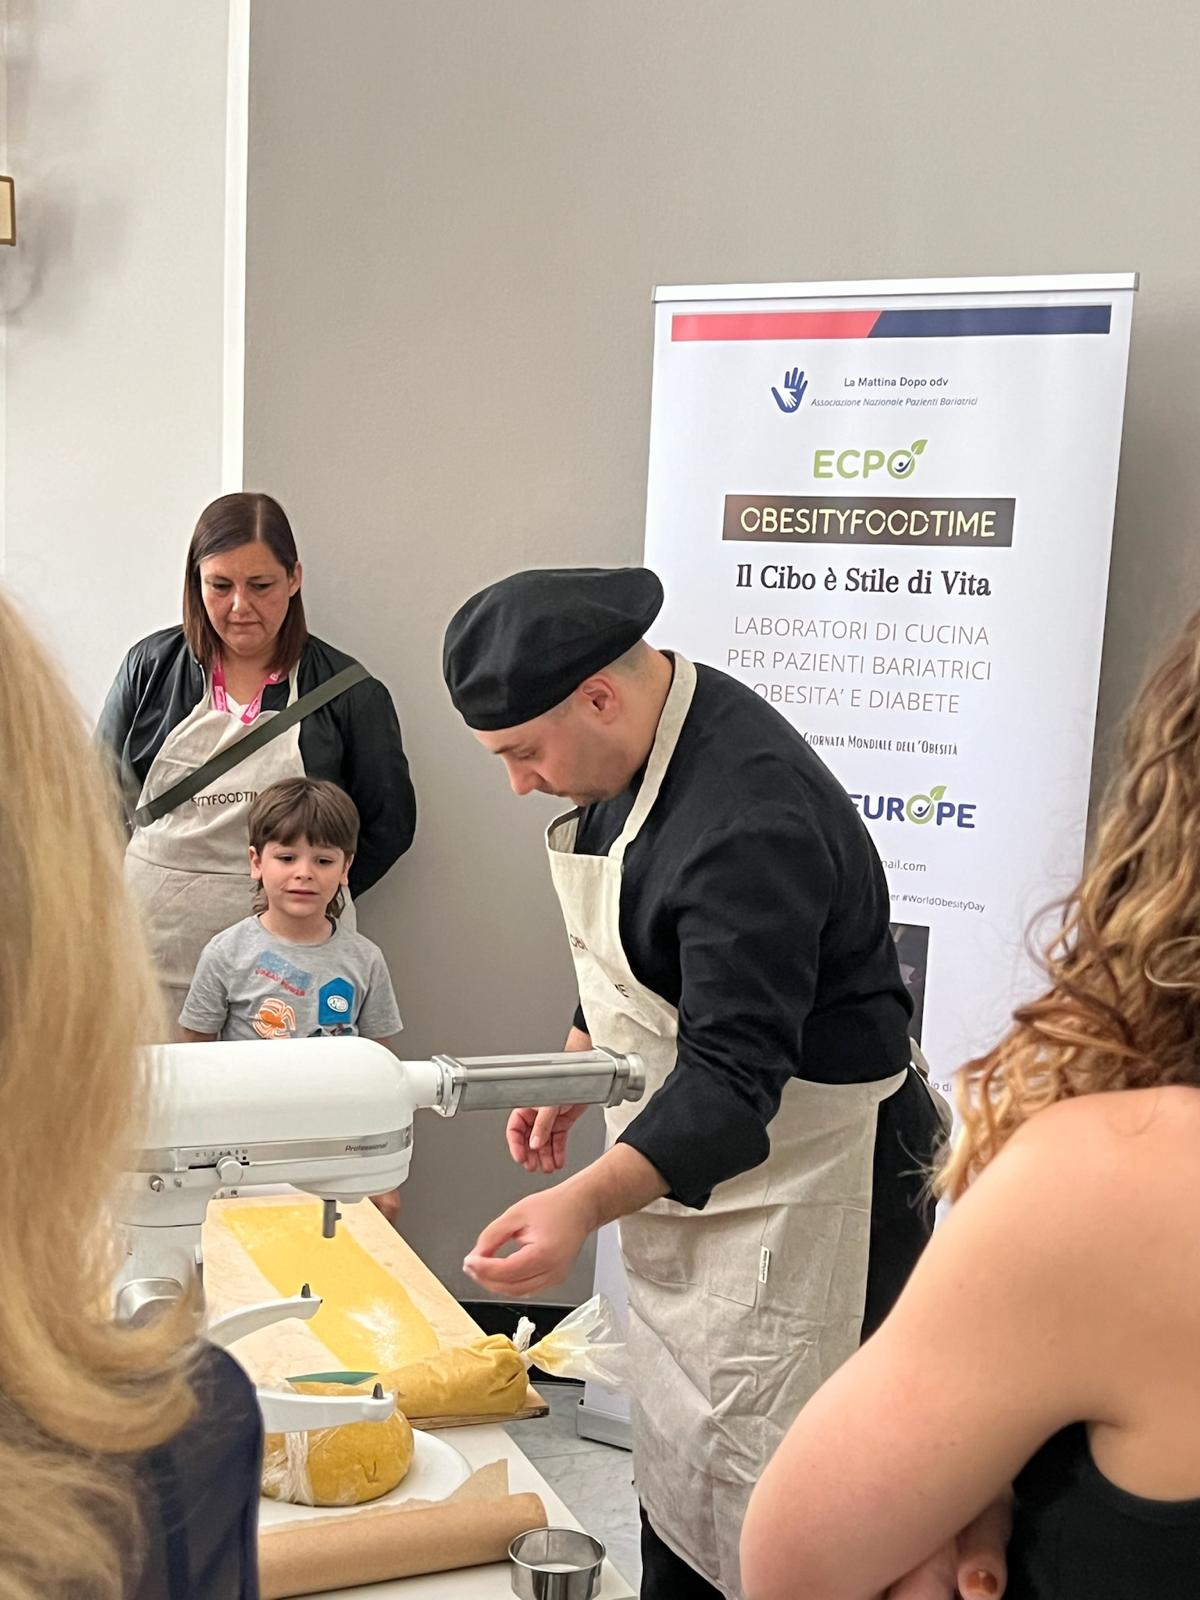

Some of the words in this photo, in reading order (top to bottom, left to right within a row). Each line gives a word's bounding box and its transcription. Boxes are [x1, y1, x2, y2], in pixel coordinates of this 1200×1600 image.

[844, 377, 856, 387] La
[858, 377, 897, 387] Mattina
[899, 376, 927, 389] Dopo
[929, 376, 949, 387] odv
[811, 397, 860, 407] Associazione
[862, 397, 904, 407] Nazionale
[905, 397, 938, 407] Pazienti
[939, 396, 979, 406] Bariatrici
[813, 447, 918, 480] ECPO
[740, 505, 997, 538] OBESITYFOODTIME
[735, 563, 753, 588] Il
[760, 564, 816, 591] Cibo
[824, 566, 838, 592] è
[845, 567, 900, 593] Stile
[907, 569, 932, 595] di
[941, 570, 992, 597] Vita
[734, 615, 868, 640] LABORATORI
[875, 622, 897, 642] DI
[904, 623, 990, 646] CUCINA
[727, 648, 766, 669] PER
[772, 650, 865, 674] PAZIENTI
[872, 656, 992, 681] BARIATRICI
[850, 688, 862, 708] E
[868, 689, 961, 714] DIABETE
[902, 893, 986, 913] #WorldObesityDay
